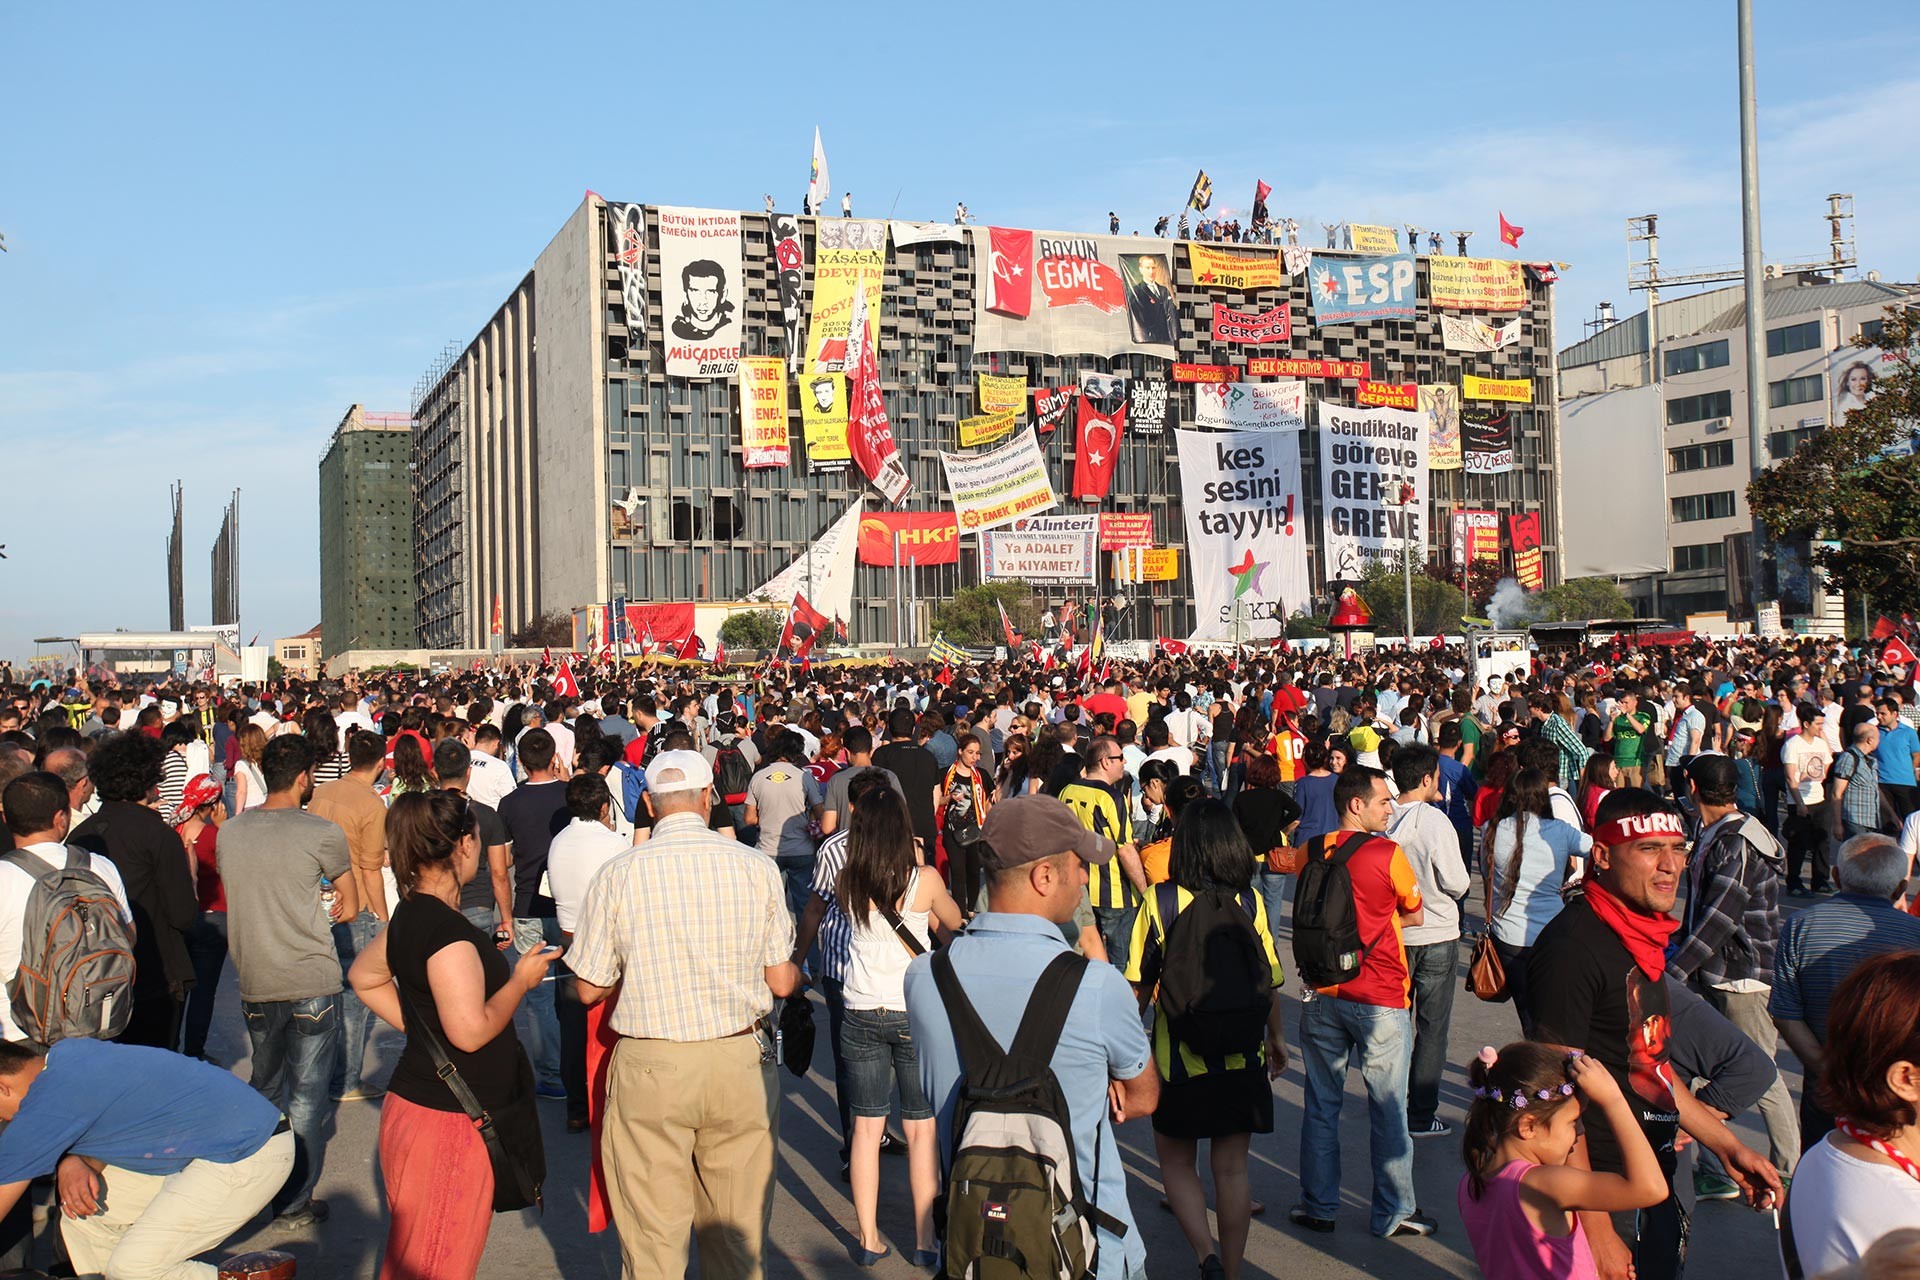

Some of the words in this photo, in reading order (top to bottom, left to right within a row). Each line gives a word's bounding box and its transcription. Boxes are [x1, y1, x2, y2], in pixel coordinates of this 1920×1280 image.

[662, 213, 695, 226] BÜTÜN
[660, 226, 698, 238] EMEĞİN
[700, 229, 739, 238] OLACAK
[1040, 239, 1099, 261] BOYUN
[818, 254, 884, 266] YAŞASIN
[1043, 260, 1104, 292] EĞME
[1220, 272, 1244, 287] TÖPG
[1342, 259, 1415, 306] ESP
[812, 284, 881, 324] SOSYAZM
[747, 368, 780, 381] ENEL
[1175, 368, 1196, 380] Ekim
[1252, 382, 1300, 399] Geliyoruz
[1367, 382, 1405, 395] HALK
[1134, 399, 1147, 409] EM
[1330, 416, 1419, 443] Sendikalar
[1216, 442, 1265, 471] kes
[1332, 441, 1418, 469] göreve
[1466, 452, 1492, 471] SÖZ
[958, 492, 975, 501] Bütün
[975, 486, 1004, 499] meydanlar
[1204, 468, 1281, 504] sesini
[1332, 469, 1420, 506] GEN
[982, 505, 1012, 523] EMEK
[1014, 488, 1051, 513] PARTİSİ
[1029, 517, 1095, 532] Alınteri
[1198, 494, 1295, 541] tayyip!
[1331, 506, 1420, 542] GREVE
[899, 525, 958, 545] HKP
[1005, 543, 1022, 554] Ya
[1025, 544, 1074, 555] ADALET
[1357, 545, 1403, 559] Devrimc
[999, 560, 1015, 571] Ya
[1018, 560, 1081, 572] KIYAMET!
[1060, 576, 1093, 585] Platformu
[1220, 600, 1281, 624] SKP
[177, 652, 185, 662] D
[1283, 738, 1304, 760] 10
